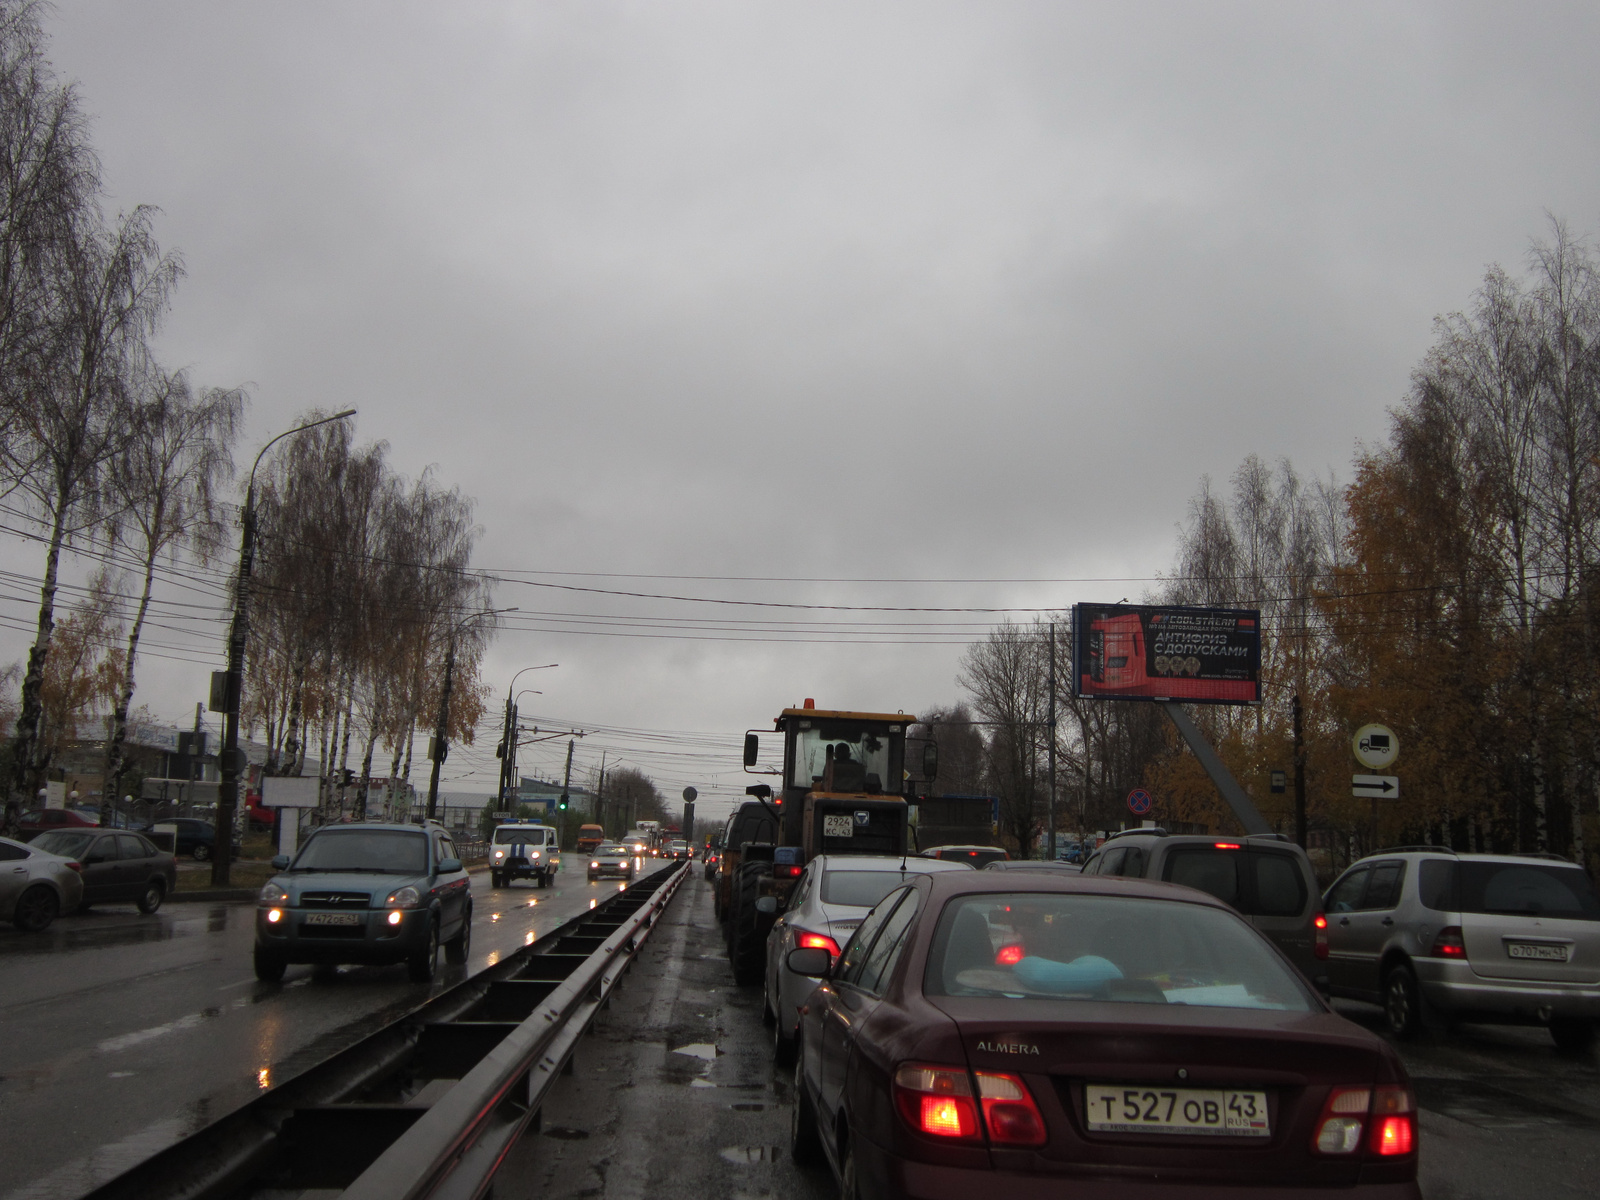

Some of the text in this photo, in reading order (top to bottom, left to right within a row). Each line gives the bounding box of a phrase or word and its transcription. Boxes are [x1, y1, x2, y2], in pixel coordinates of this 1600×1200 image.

[1169, 615, 1236, 627] COOLSTREAM
[1167, 624, 1210, 633] АВТОЗАВОДАХ
[1155, 631, 1228, 644] АНТИФРИЗ
[1154, 644, 1248, 657] С ДОПУСКАМИ
[827, 818, 850, 826] 2924
[976, 1041, 1040, 1055] ALMERA
[1227, 1093, 1258, 1119] 43
[1227, 1117, 1250, 1128] RUS
